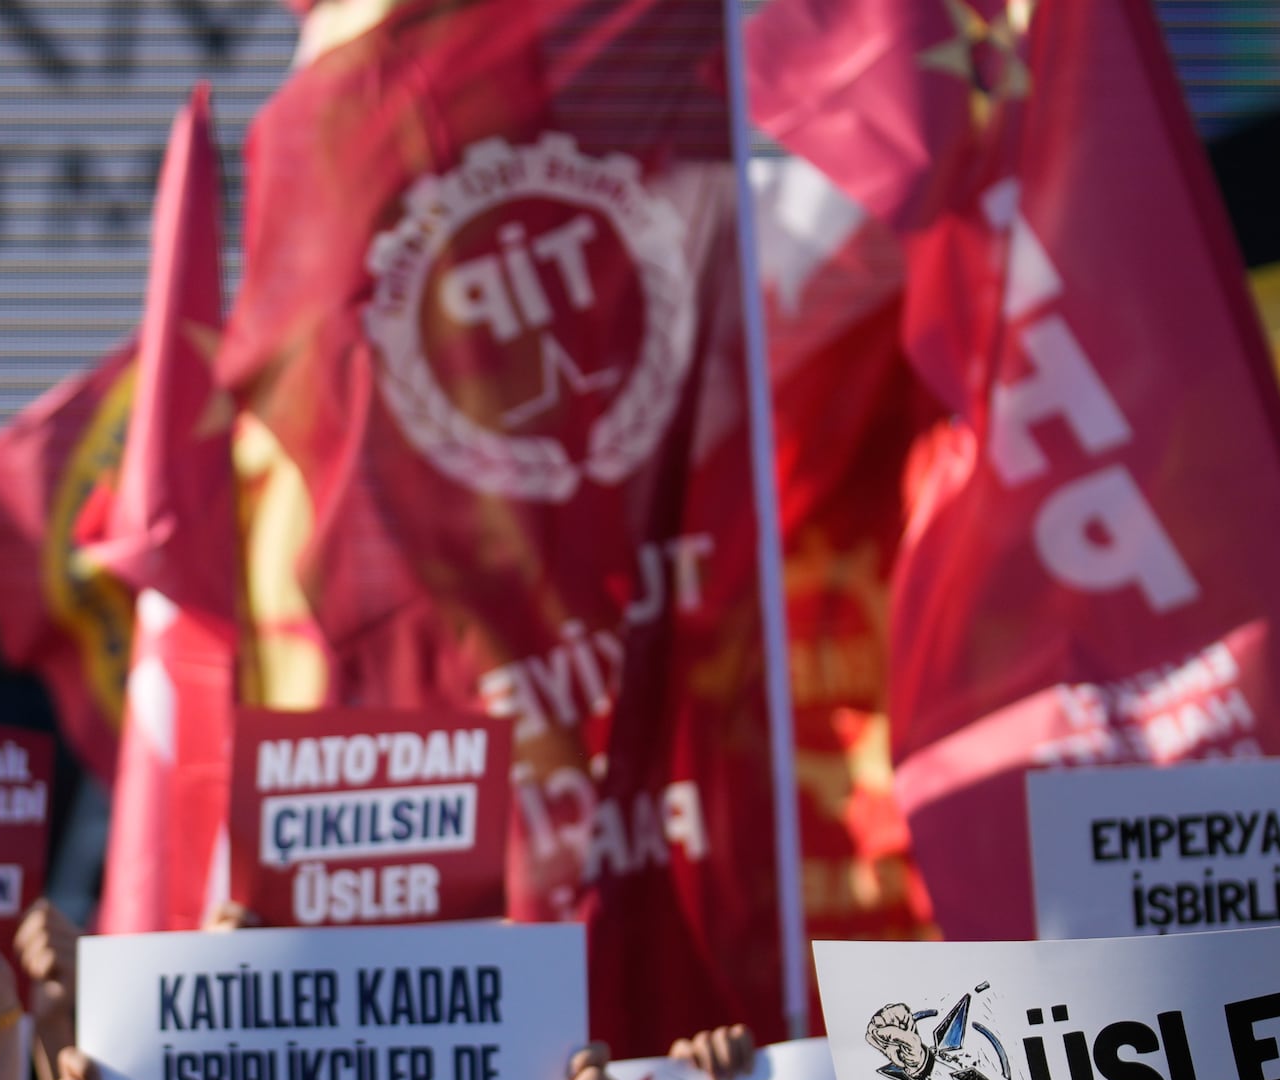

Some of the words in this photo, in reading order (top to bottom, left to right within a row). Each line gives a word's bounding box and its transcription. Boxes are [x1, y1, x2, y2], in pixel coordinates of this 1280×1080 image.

[257, 728, 488, 793] NATO'DAN
[271, 794, 466, 865] ÇIKILSIN
[292, 862, 440, 926] ÜSLER
[158, 962, 338, 1032] KATİLLER
[355, 965, 503, 1027] KADAR
